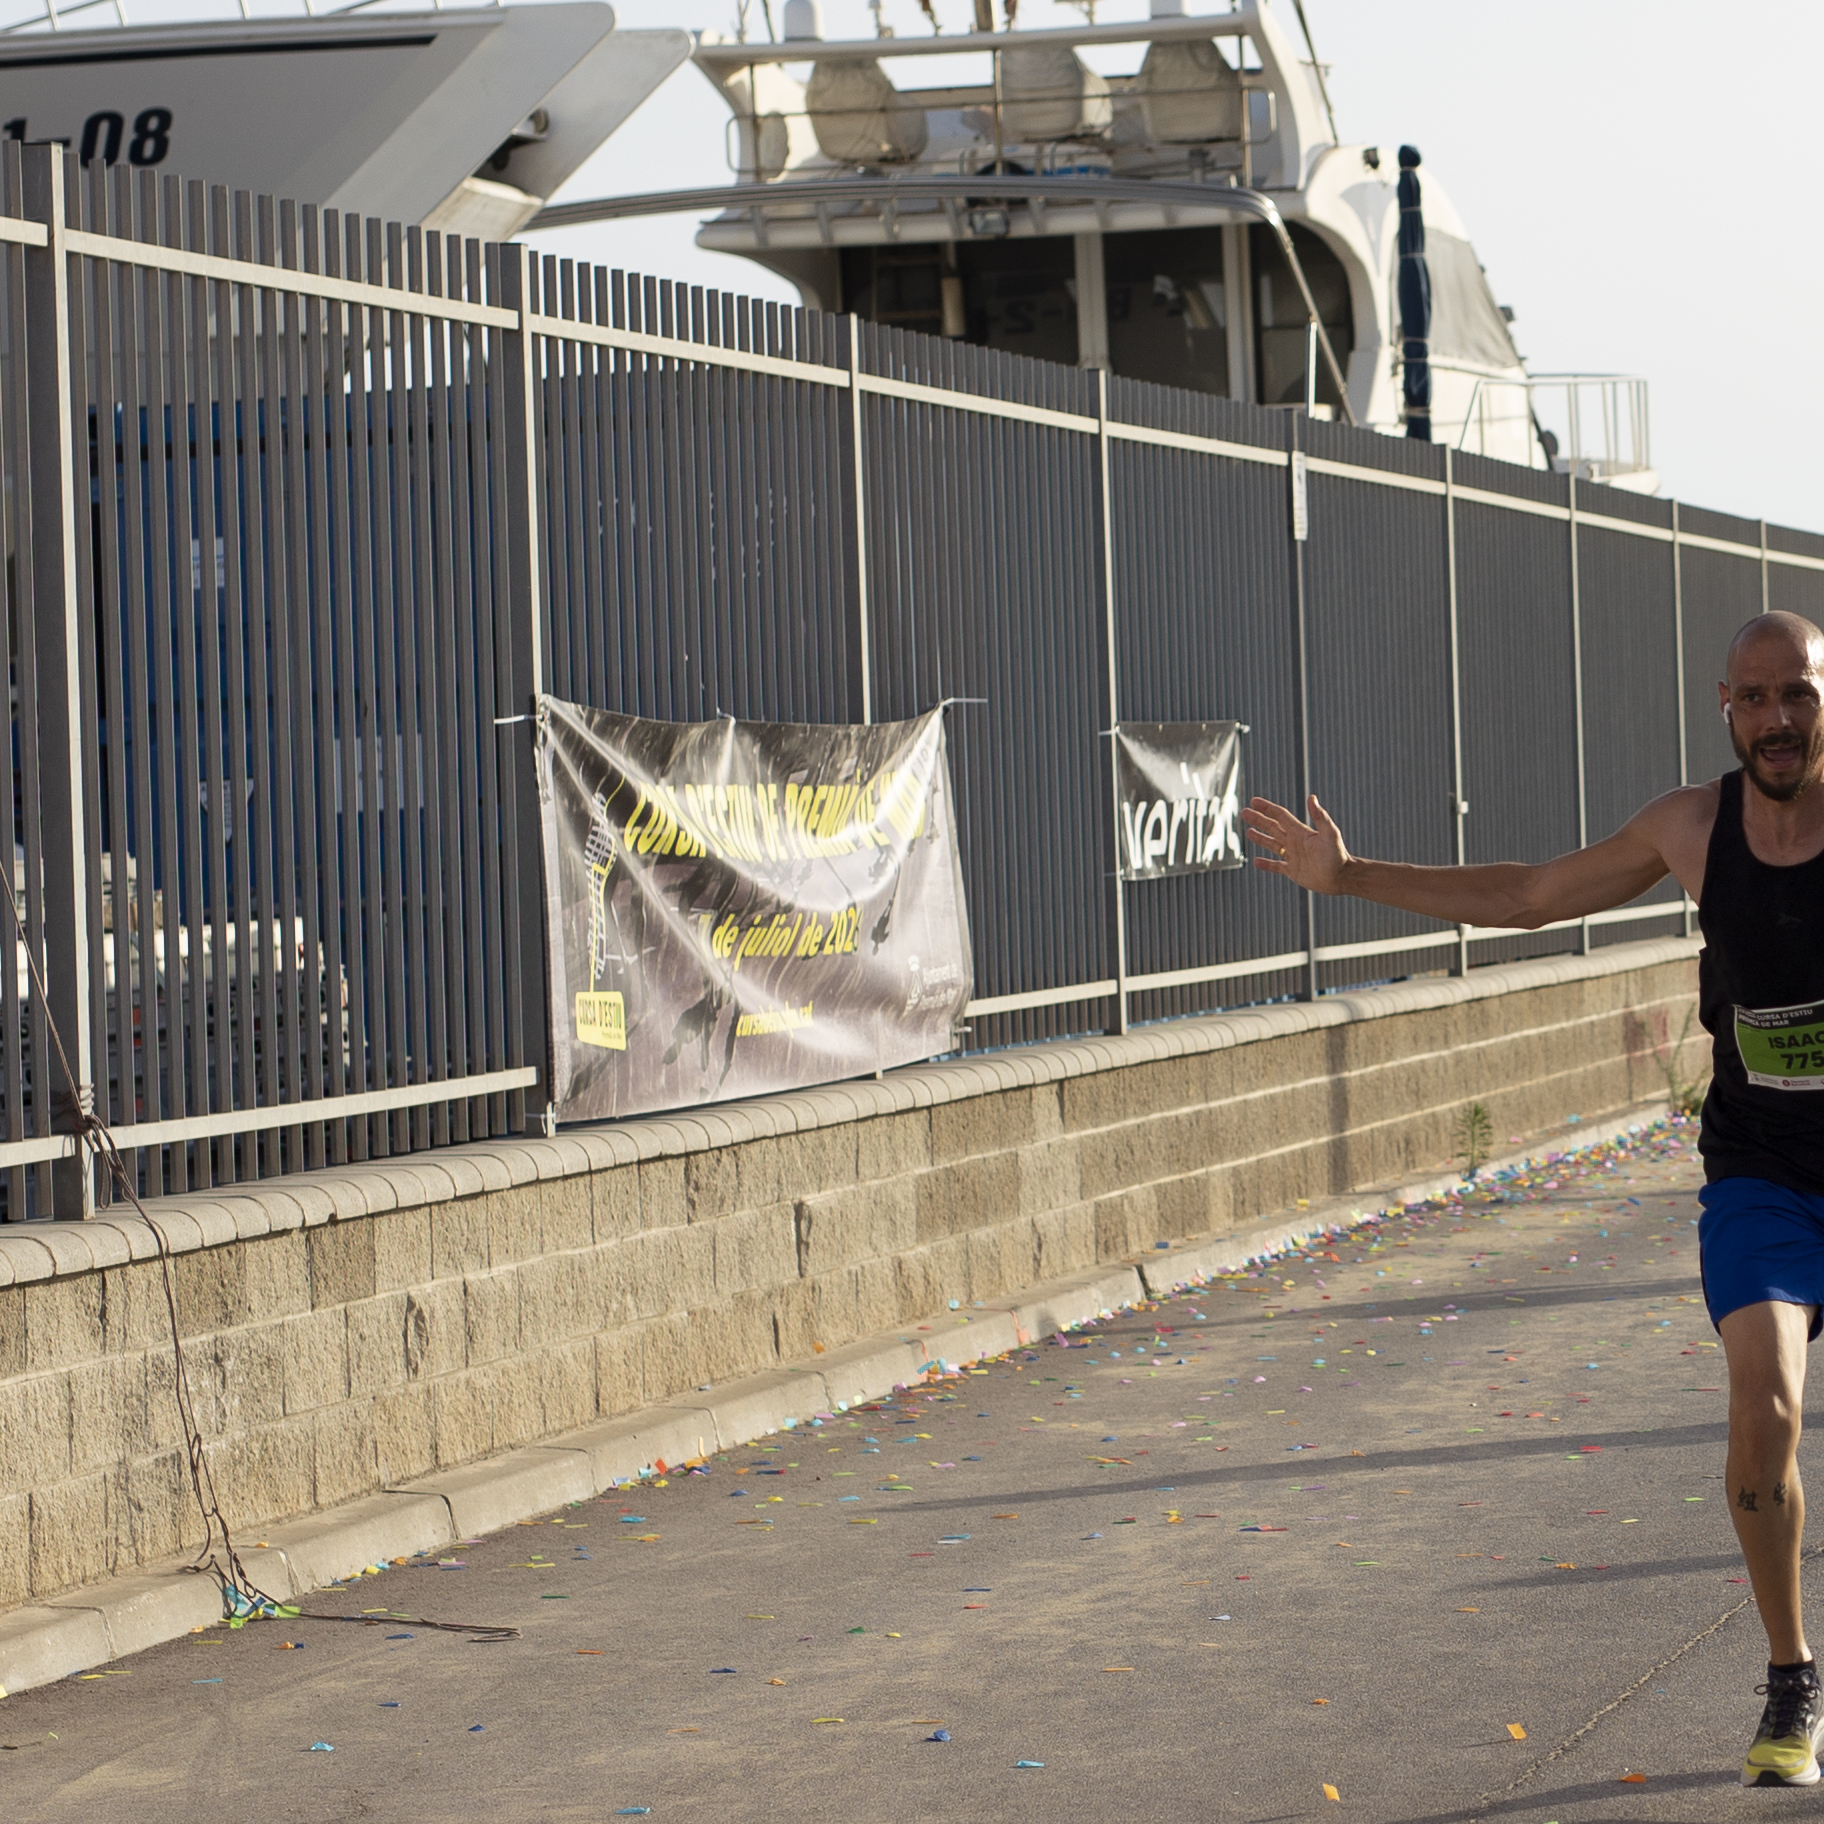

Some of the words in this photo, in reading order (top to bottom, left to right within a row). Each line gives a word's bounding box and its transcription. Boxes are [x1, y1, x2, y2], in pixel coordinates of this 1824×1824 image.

[712, 912, 739, 960] de
[732, 913, 802, 972] juliol
[797, 912, 824, 957] de
